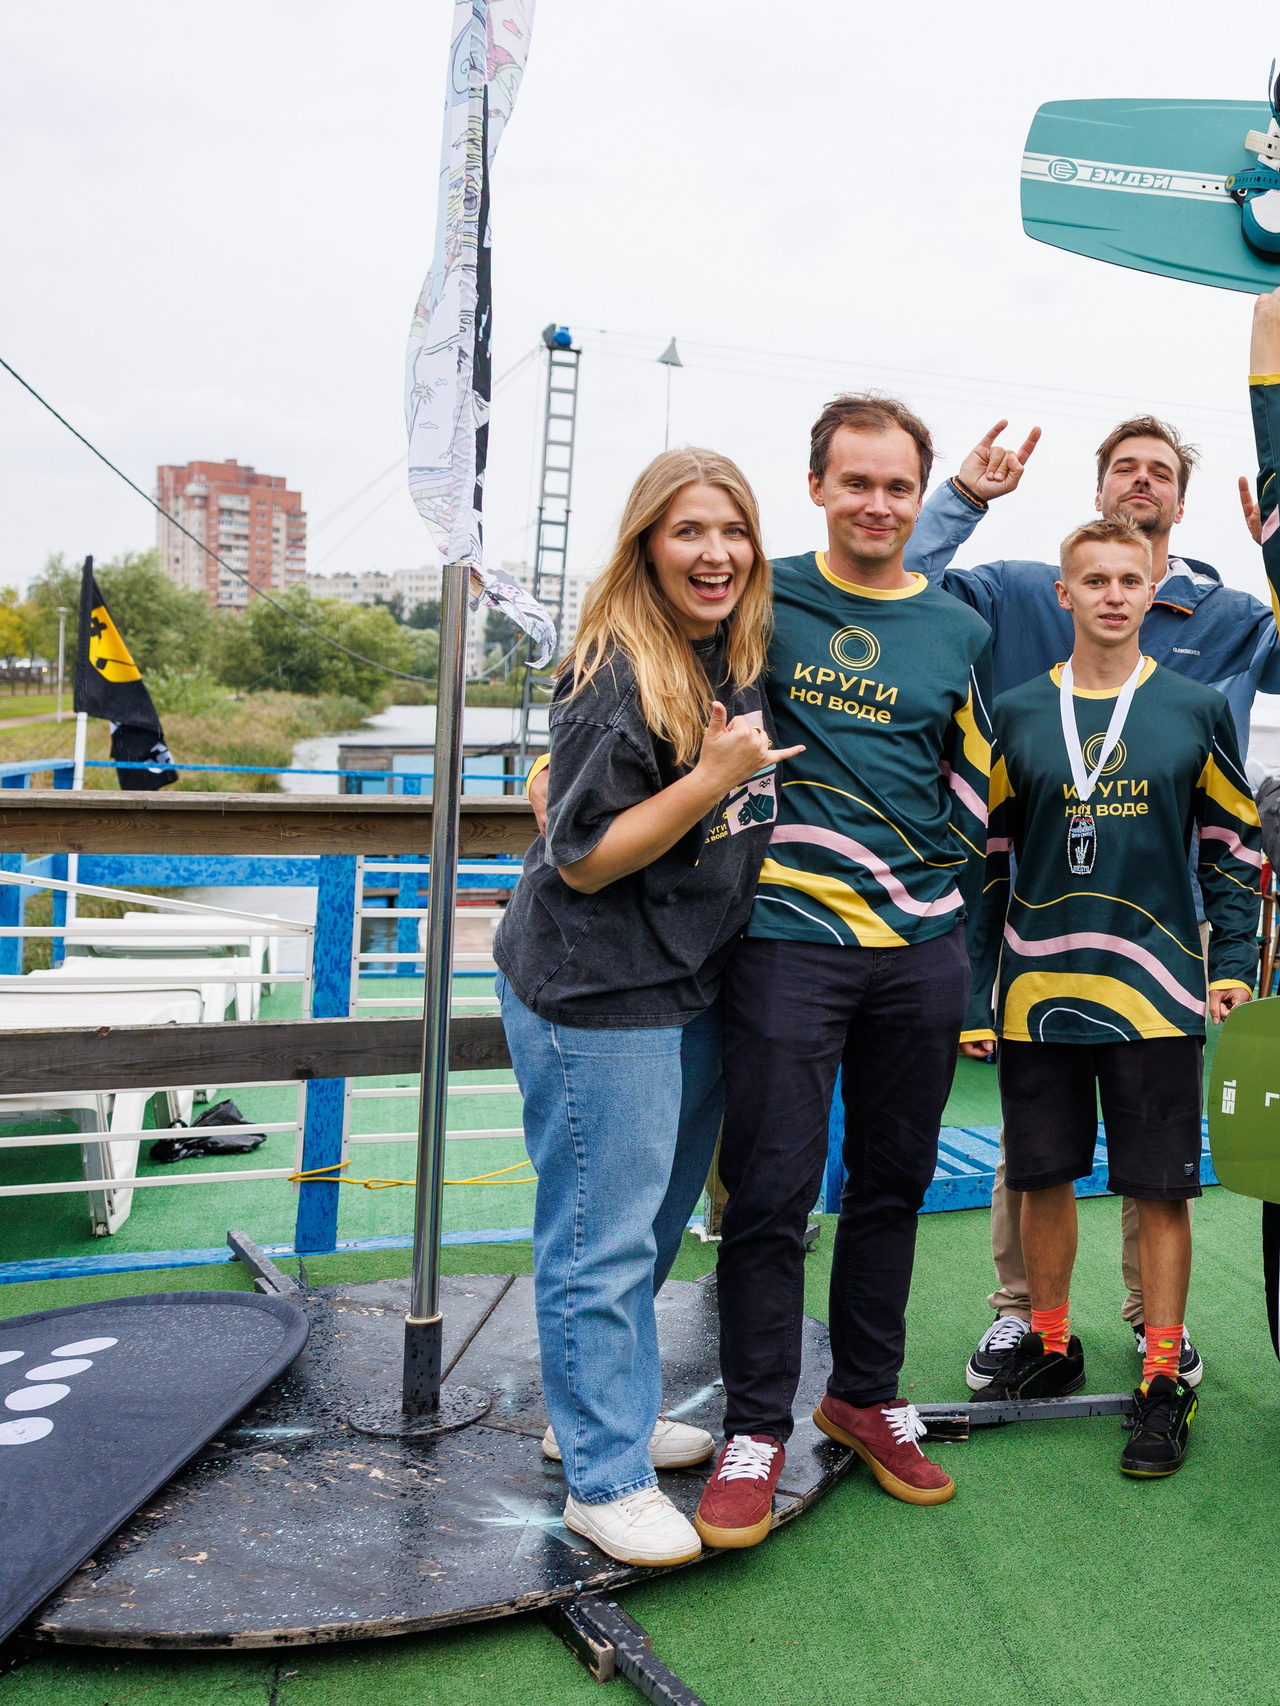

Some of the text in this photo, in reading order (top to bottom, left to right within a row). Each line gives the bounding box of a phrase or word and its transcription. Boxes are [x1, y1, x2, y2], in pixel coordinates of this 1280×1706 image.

[1091, 168, 1171, 189] ЭМДЭЙ
[793, 662, 899, 706] КРУГИ
[789, 686, 892, 724] на воде
[1062, 779, 1148, 800] КУГИ
[1096, 802, 1148, 818] воде
[709, 823, 727, 836] УГИ
[1221, 1079, 1237, 1115] 155
